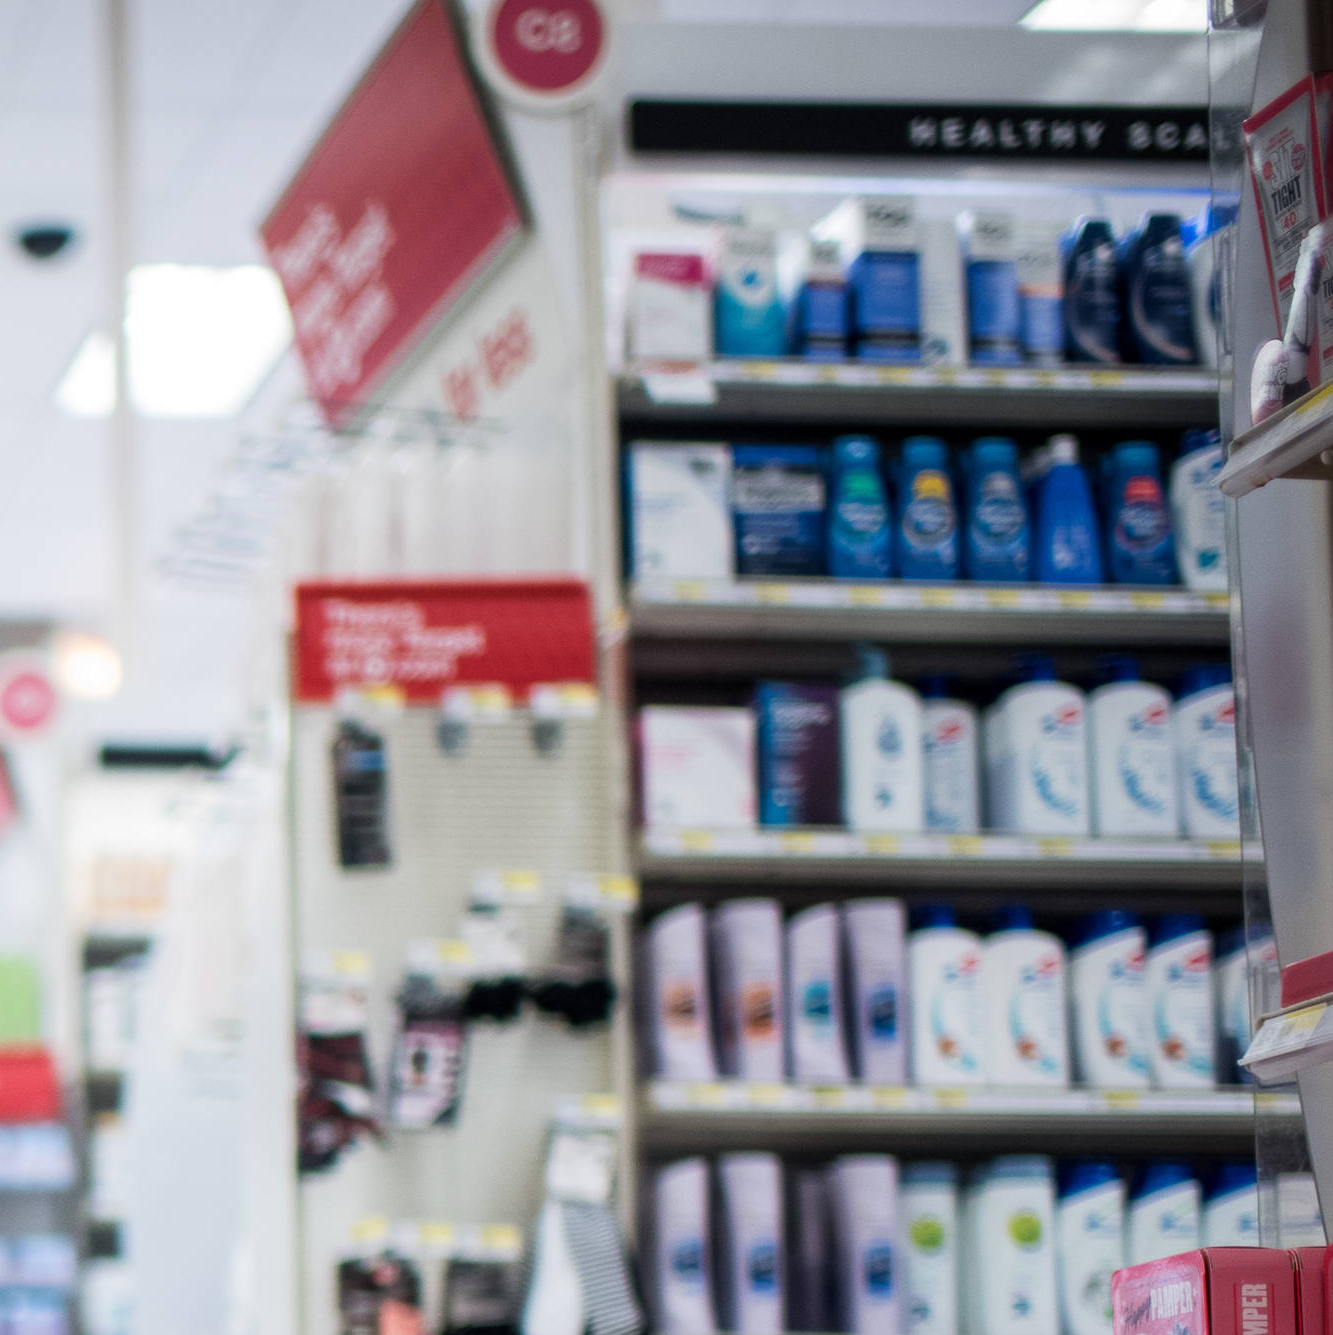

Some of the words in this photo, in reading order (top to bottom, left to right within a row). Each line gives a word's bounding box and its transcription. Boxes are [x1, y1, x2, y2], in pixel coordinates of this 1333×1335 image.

[908, 116, 1107, 149] HEALTHY
[1271, 174, 1302, 216] TIGHT
[1150, 1280, 1194, 1321] PAMPER
